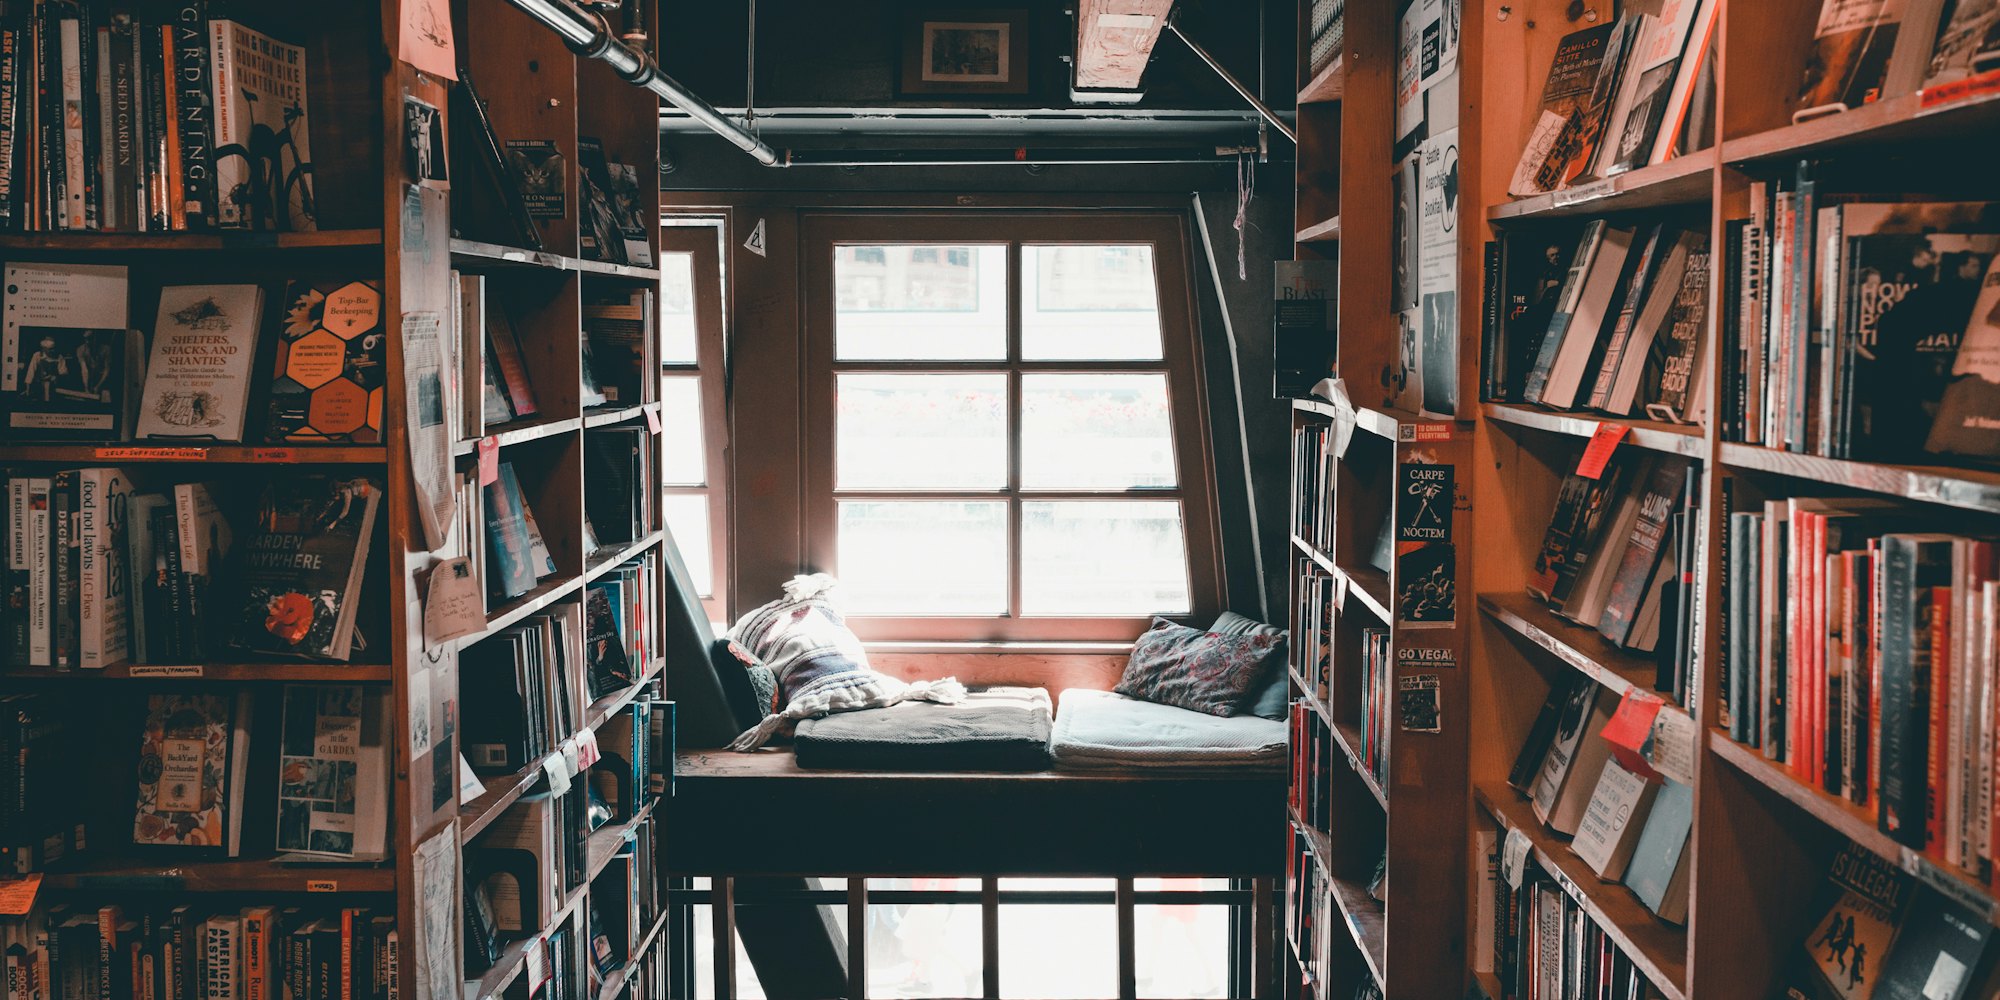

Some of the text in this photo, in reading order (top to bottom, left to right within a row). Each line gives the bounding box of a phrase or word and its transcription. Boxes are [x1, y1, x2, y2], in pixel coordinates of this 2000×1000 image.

[3, 30, 13, 53] ASK
[251, 35, 258, 50] &
[259, 37, 270, 55] THE
[271, 41, 285, 58] ART
[287, 48, 298, 65] OF
[1559, 38, 1599, 56] CAMILLO
[2, 56, 12, 78] THE
[236, 47, 301, 83] MOUNTAIN BIKE
[1553, 65, 1563, 75] The
[1563, 63, 1575, 72] Birth
[1557, 52, 1580, 65] SITTE
[236, 66, 301, 101] MAINTENANCE
[1560, 71, 1582, 82] Planning
[0, 83, 12, 128] FAMILY
[118, 78, 128, 111] SEED
[119, 113, 130, 167] GARDEN
[1425, 170, 1448, 192] Anarchist
[1425, 196, 1444, 218] Bookfair
[1749, 227, 1761, 301] DEFIANT
[338, 296, 369, 306] Top-Bar
[1513, 295, 1526, 304] THE
[330, 307, 374, 317] Beekeeping
[161, 346, 238, 356] SHACKS, AND
[171, 335, 230, 345] SHELTERS,
[168, 357, 227, 366] SHANTIES
[1418, 432, 1450, 440] EVERYTHING
[1425, 424, 1447, 432] CHANGE
[1409, 469, 1446, 481] CARPE
[15, 495, 23, 529] RESILIENT
[1640, 492, 1672, 523] SLUMS
[84, 481, 97, 570] food not lawns
[179, 495, 194, 560] This Organic Life
[1402, 527, 1446, 538] NOCTEM
[15, 531, 23, 565] GARDENER
[58, 510, 67, 606] DECKSCAPING
[84, 572, 94, 620] H.C. Flores
[171, 578, 179, 612] BOUND
[1398, 648, 1416, 660] GO
[1926, 603, 1942, 787] THE ISLAMOPHOBIA INDUSTRY
[321, 722, 357, 732] Discoveries
[177, 744, 190, 752] The
[330, 734, 348, 743] in the
[167, 754, 198, 762] BackYard
[319, 745, 356, 755] GARDEN
[164, 765, 199, 773] Orchardist
[1603, 768, 1629, 790] LOCKING
[1592, 795, 1605, 810] Crime
[1581, 819, 1607, 845] Black America
[1830, 850, 1850, 879] IS
[1845, 858, 1901, 908] ILLEGAL
[100, 914, 109, 937] URBAN
[173, 929, 181, 944] THE
[342, 937, 350, 964] HEAVEN
[209, 928, 219, 998] PASTIMES
[219, 929, 230, 998] AMERICAN
[294, 941, 303, 998] ROBBIE ROGERS
[9, 966, 17, 993] BOOK
[101, 965, 111, 989] TRICKS
